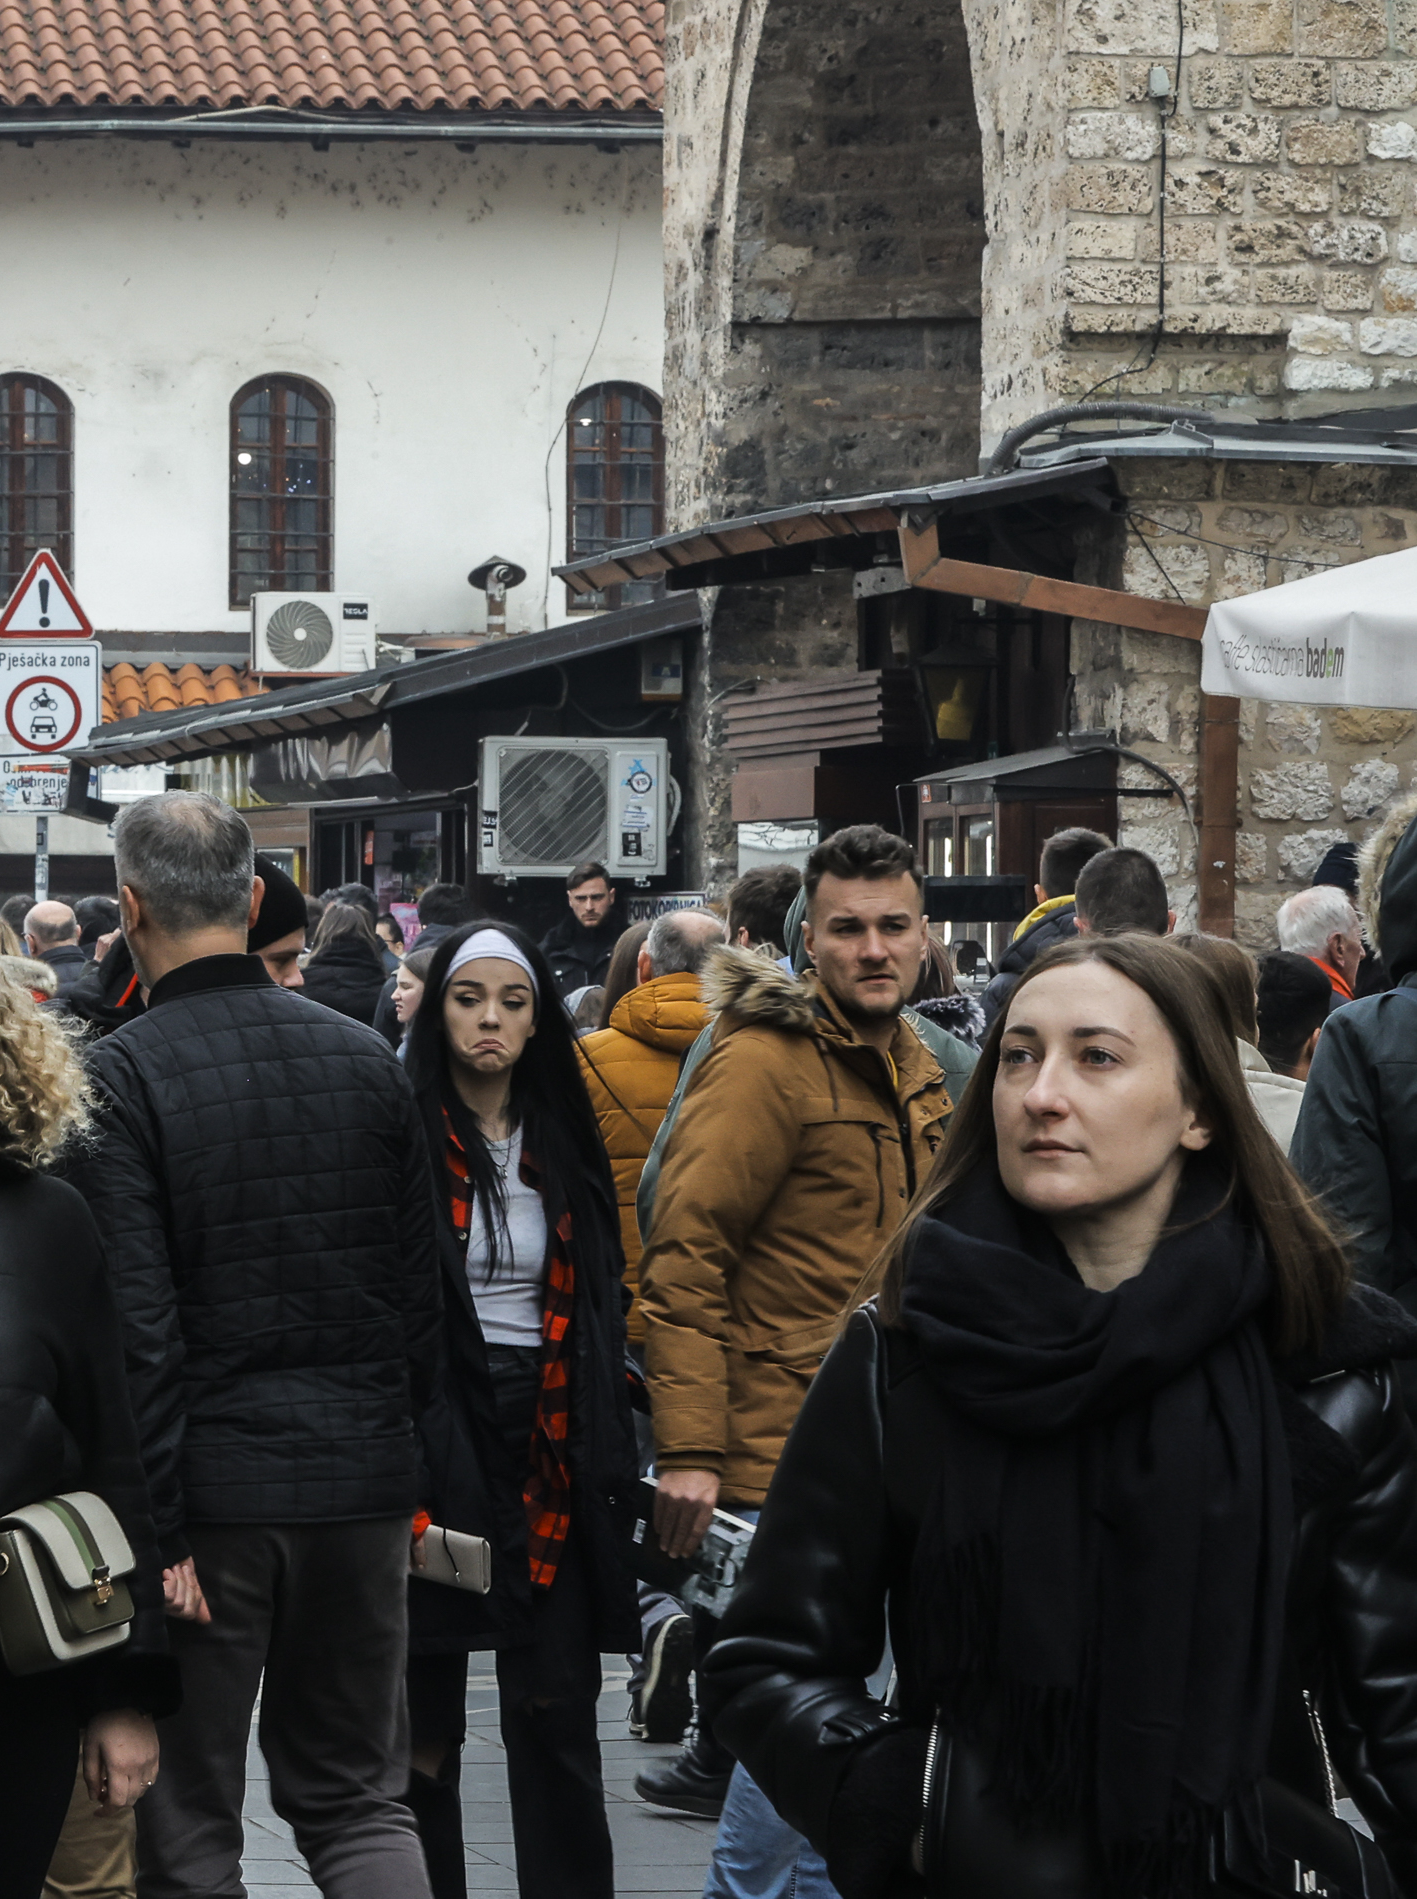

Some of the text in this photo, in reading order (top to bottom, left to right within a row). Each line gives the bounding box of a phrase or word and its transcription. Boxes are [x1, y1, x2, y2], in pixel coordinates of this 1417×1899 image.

[60, 655, 90, 667] zona
[1306, 637, 1344, 678] badem
[10, 776, 68, 792] odbrenje
